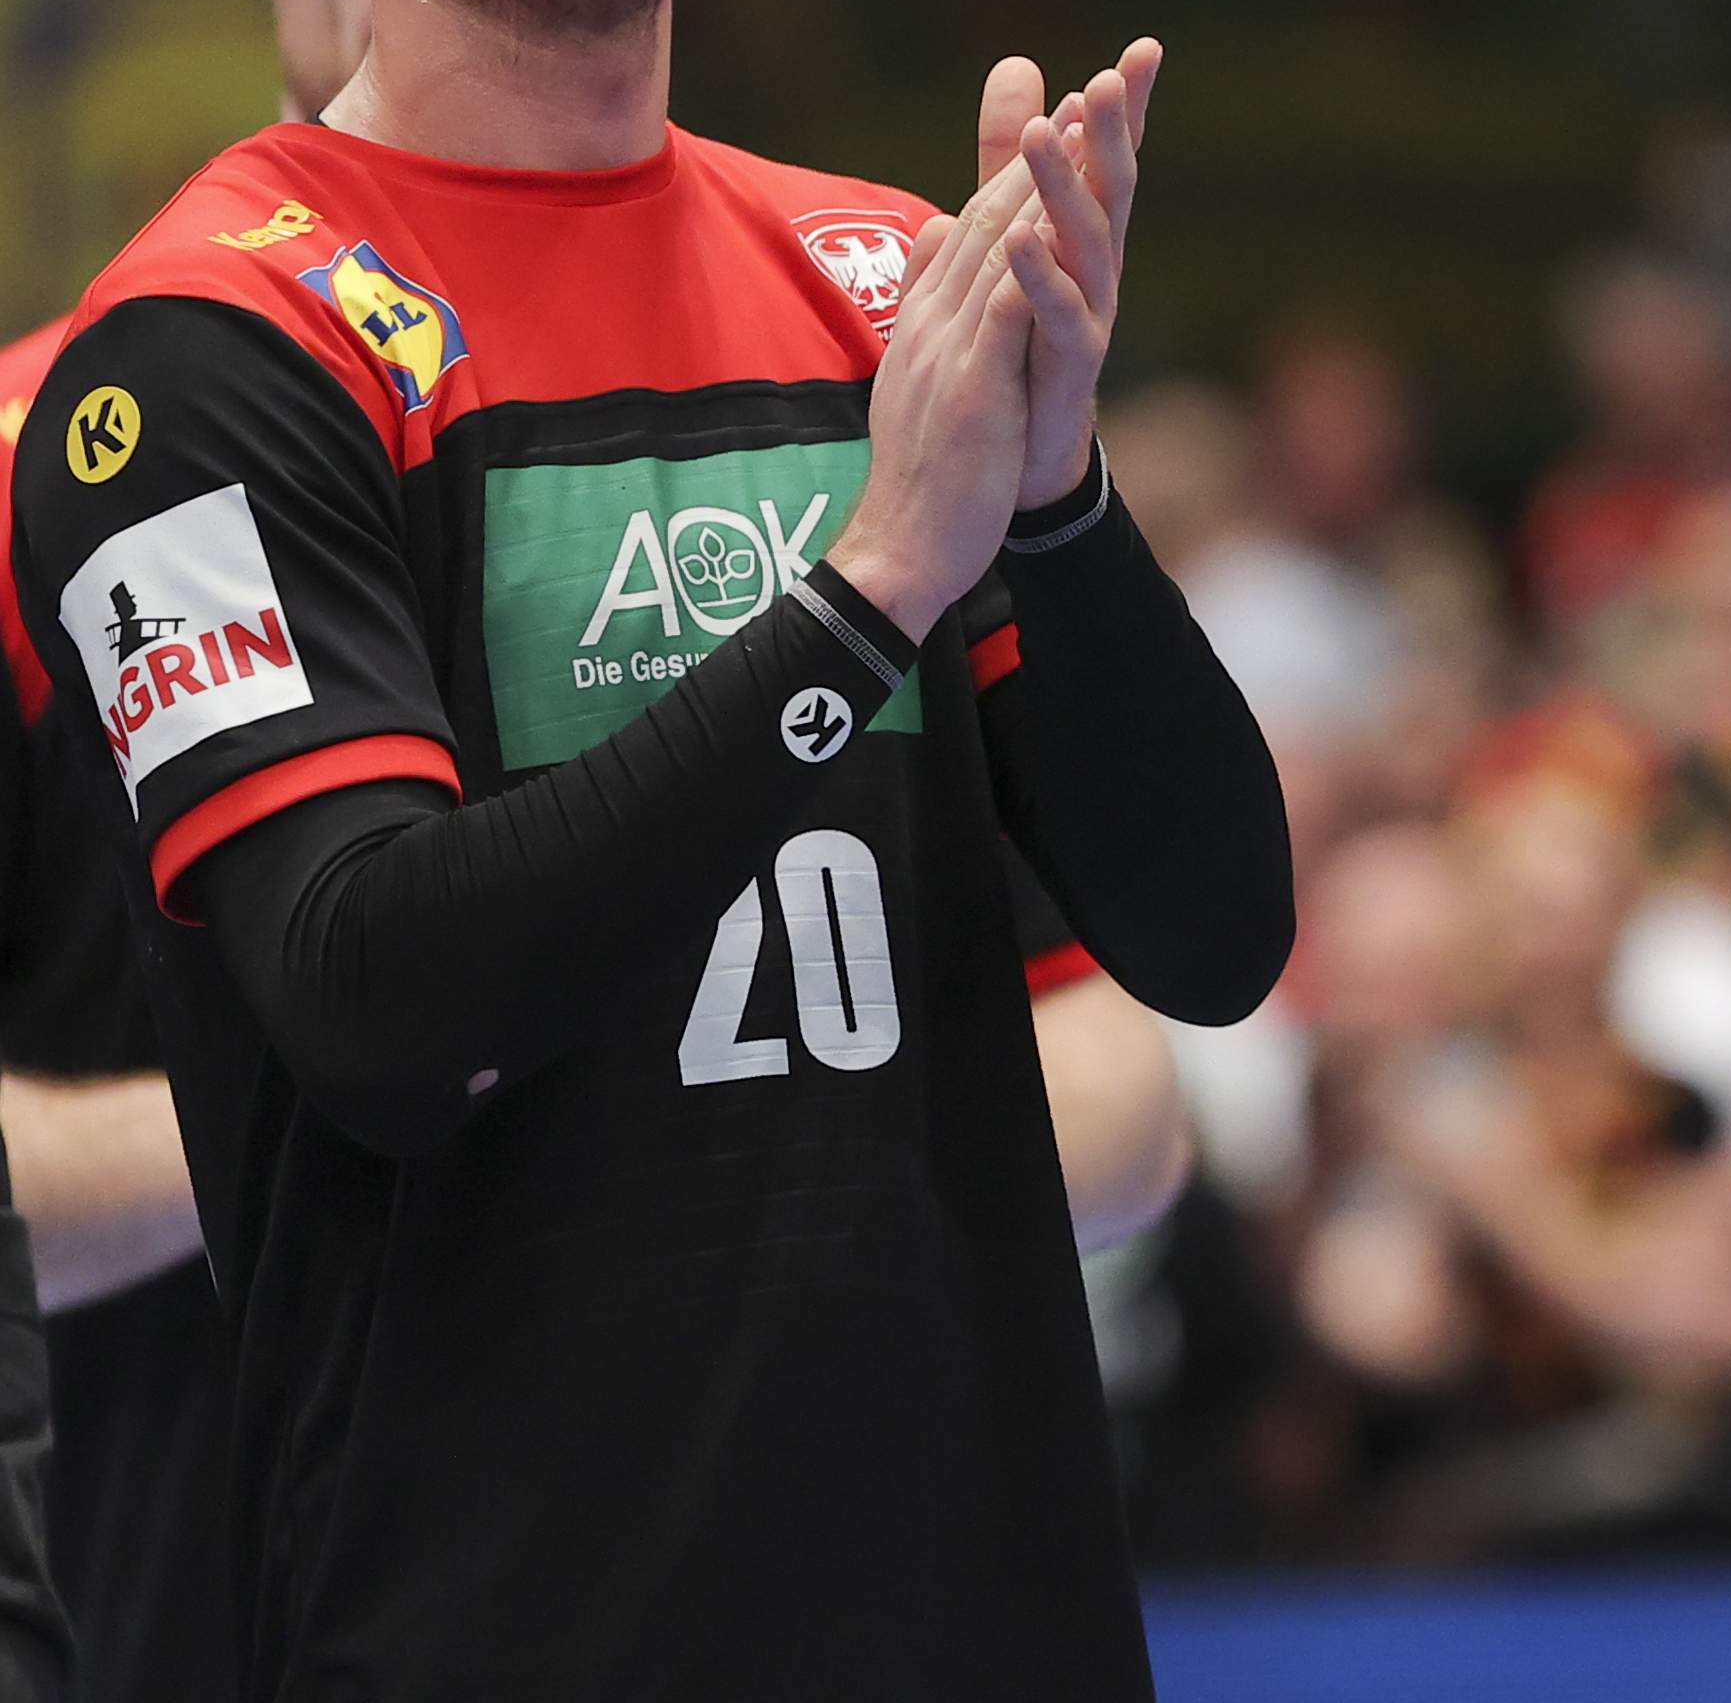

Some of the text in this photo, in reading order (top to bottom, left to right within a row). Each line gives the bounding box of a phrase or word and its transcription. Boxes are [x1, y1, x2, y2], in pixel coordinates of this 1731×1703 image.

[578, 493, 831, 647] AOK
[572, 656, 624, 689] Die
[677, 828, 901, 1087] 20
